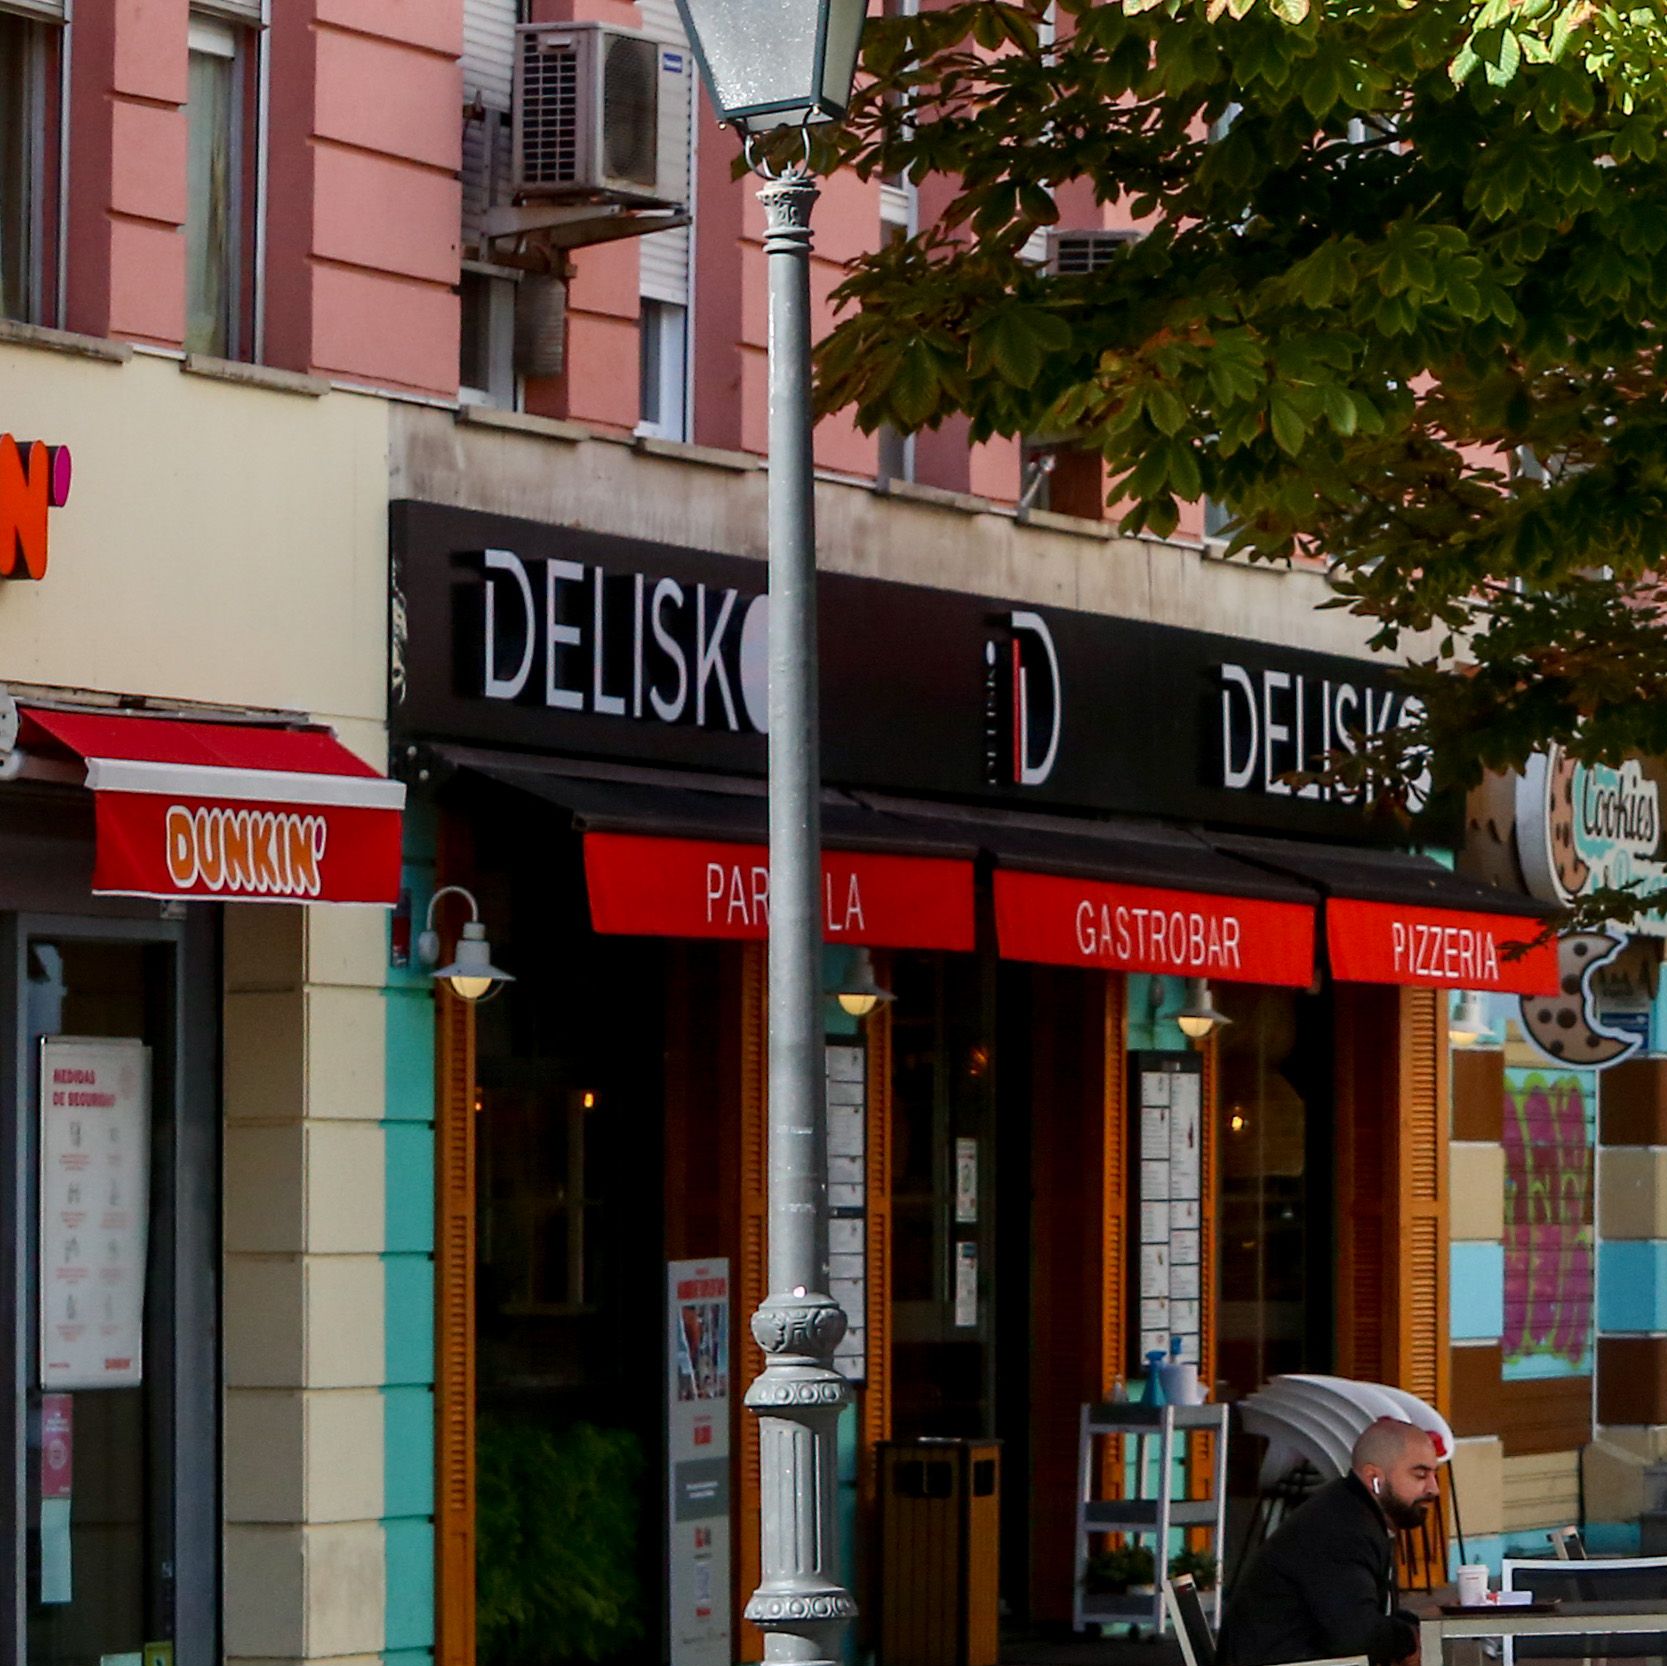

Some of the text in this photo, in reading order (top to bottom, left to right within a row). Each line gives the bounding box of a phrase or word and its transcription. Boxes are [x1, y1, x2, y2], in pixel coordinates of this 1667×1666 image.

[166, 805, 327, 897] DUNKIN'
[1076, 899, 1242, 971] GASTROBAR
[1392, 922, 1500, 981] PIZZERIA
